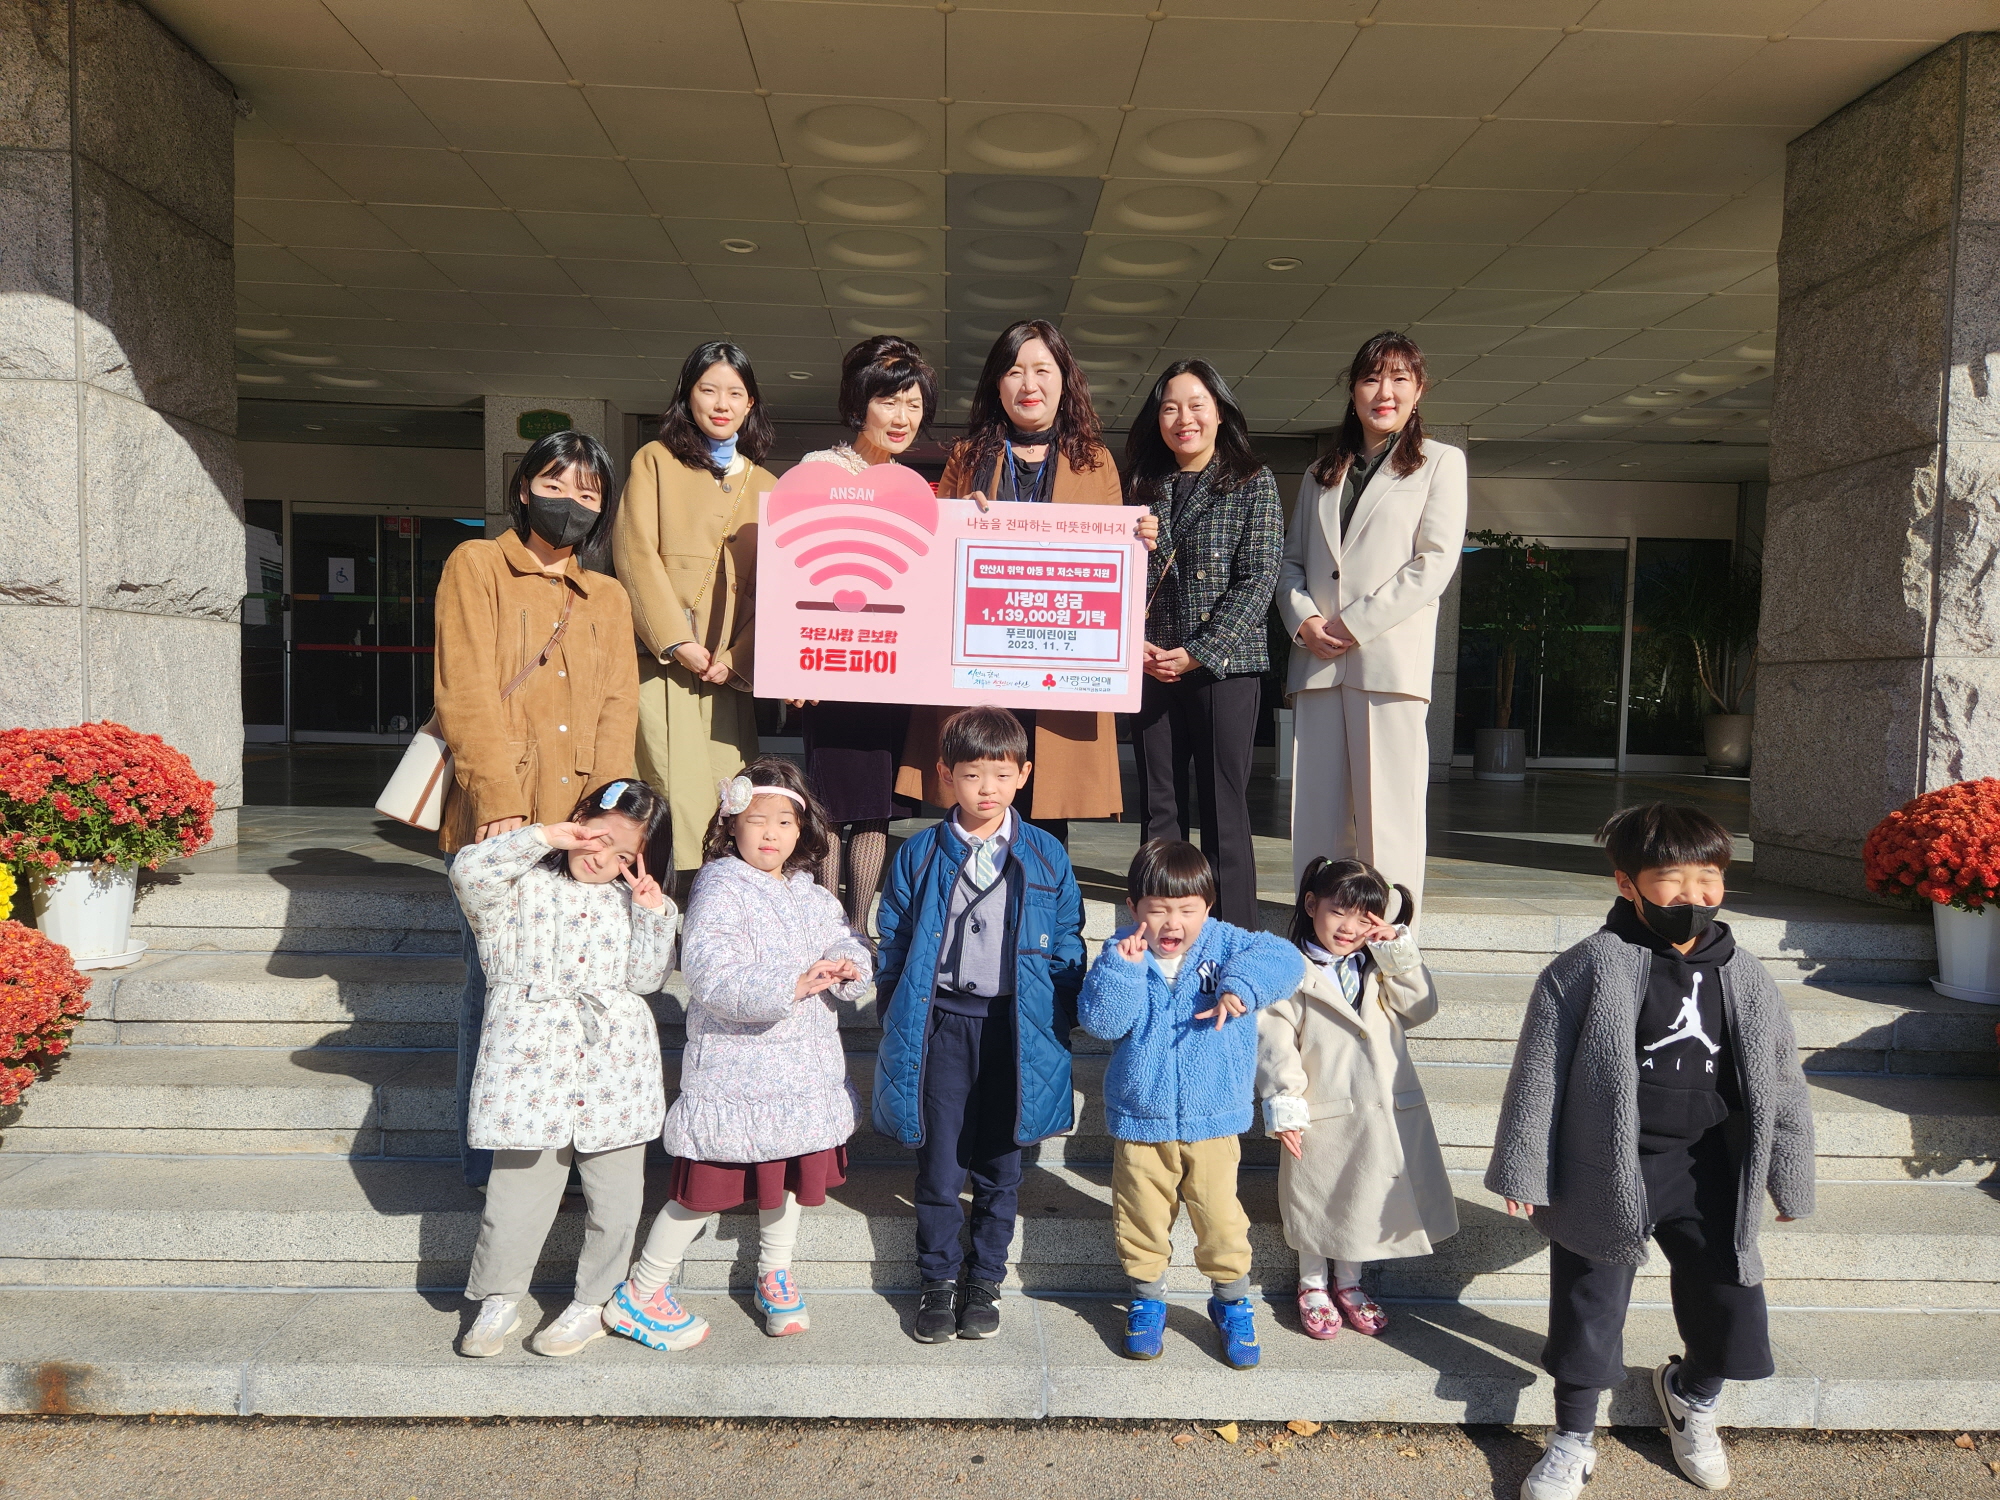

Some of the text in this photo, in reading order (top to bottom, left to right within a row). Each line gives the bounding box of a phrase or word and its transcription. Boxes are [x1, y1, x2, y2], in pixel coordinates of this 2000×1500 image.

[829, 487, 875, 501] ANSAN
[967, 517, 1126, 535] 나눔을 전파하는 따뜻한에너지
[979, 564, 1110, 578] 안산시 취약 아동 및 저소득층 지원
[1005, 591, 1083, 609] 사랑의 성금
[982, 608, 1106, 626] 1,139,000원 기탁
[800, 627, 898, 644] 작은사랑 큰보람
[1006, 628, 1077, 640] 푸르미어린이집
[1008, 640, 1074, 651] 2023. 11. 7.
[800, 647, 896, 674] 하트파이
[1059, 675, 1112, 687] 사랑의열매
[1642, 1058, 1714, 1074] AIR
[616, 1320, 668, 1351] FILA
